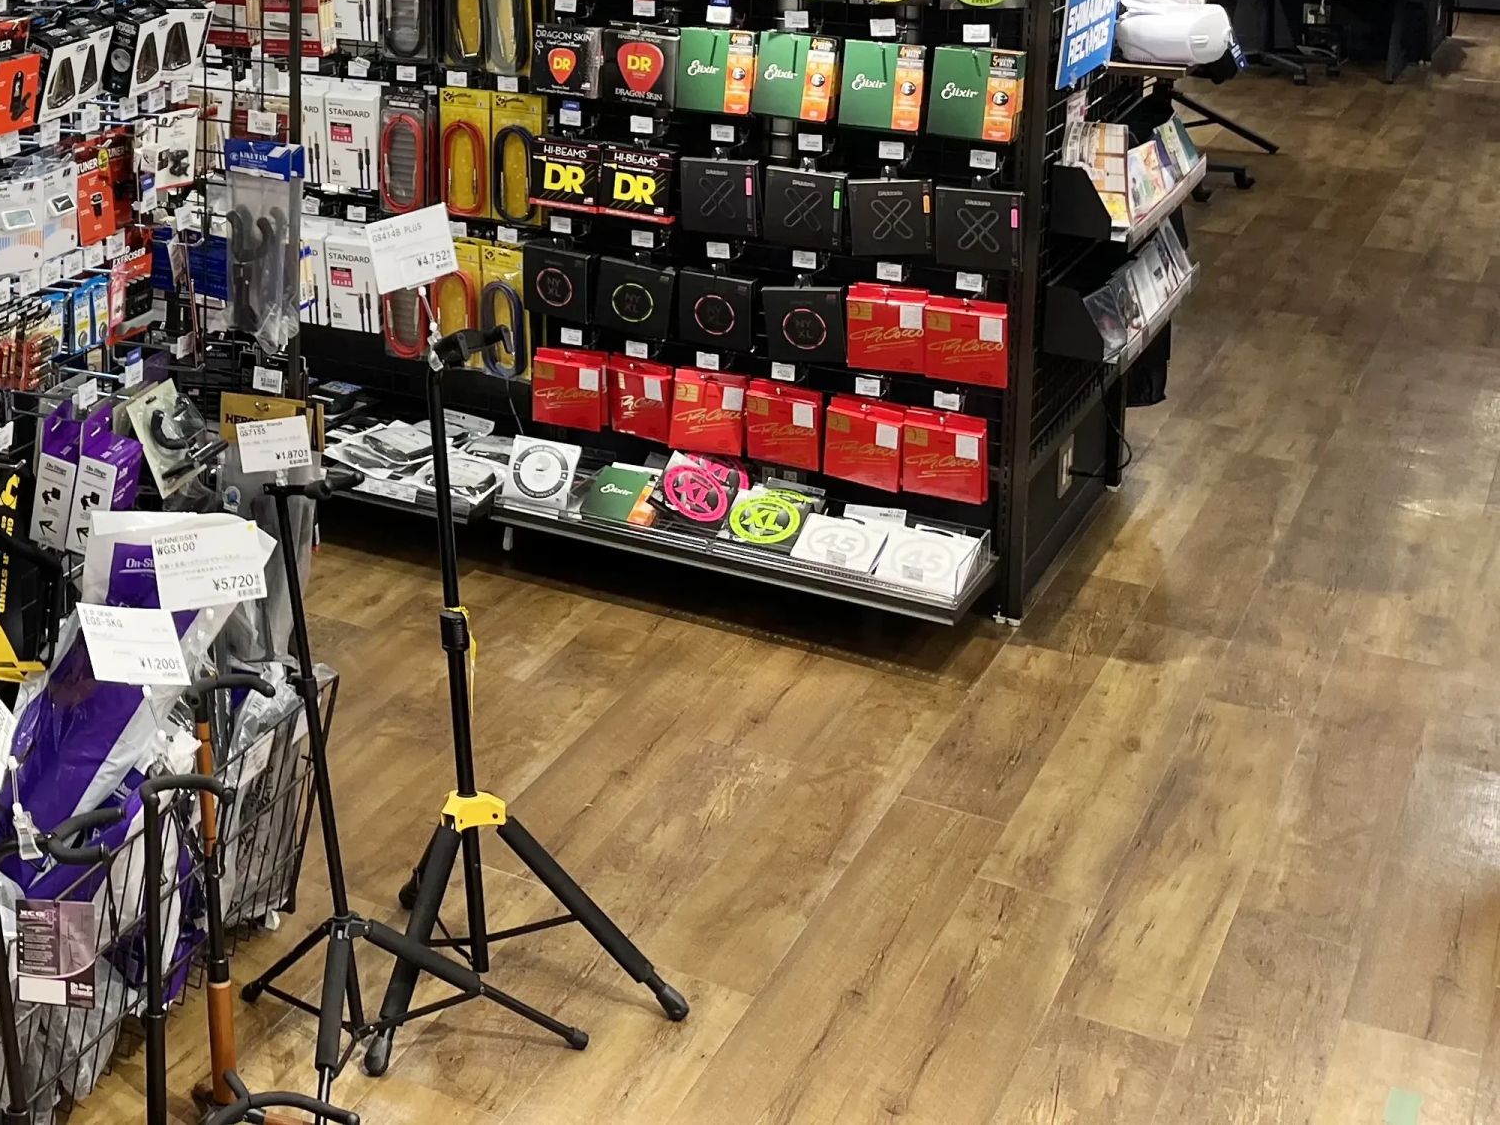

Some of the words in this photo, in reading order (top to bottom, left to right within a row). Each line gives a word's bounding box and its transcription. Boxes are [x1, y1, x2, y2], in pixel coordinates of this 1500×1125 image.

[535, 29, 572, 42] DRAGON
[573, 31, 594, 43] SKIN
[552, 55, 572, 72] DR
[627, 54, 652, 73] DR
[687, 58, 721, 76] Elixir
[763, 63, 799, 81] Elixir
[850, 73, 888, 91] Elixir
[614, 87, 643, 99] DRAGON
[644, 90, 663, 102] SKIN
[940, 82, 979, 100] Elixir
[328, 106, 371, 119] STANDARD
[543, 143, 588, 160] HI-BEAMS
[613, 151, 660, 168] HI-BEAMS
[77, 158, 99, 175] TUNER
[544, 162, 586, 195] DR
[612, 171, 657, 206] DR
[112, 247, 146, 270] EXERCISER
[328, 251, 371, 264] STANDARD
[600, 483, 634, 497] Elixir
[674, 477, 714, 512] XL
[740, 508, 784, 531] XL
[154, 533, 199, 546] HENNESSEY
[816, 532, 861, 552] 45
[156, 542, 196, 557] WGS100
[212, 574, 255, 593] ¥5,720
[139, 657, 175, 671] ¥1,200
